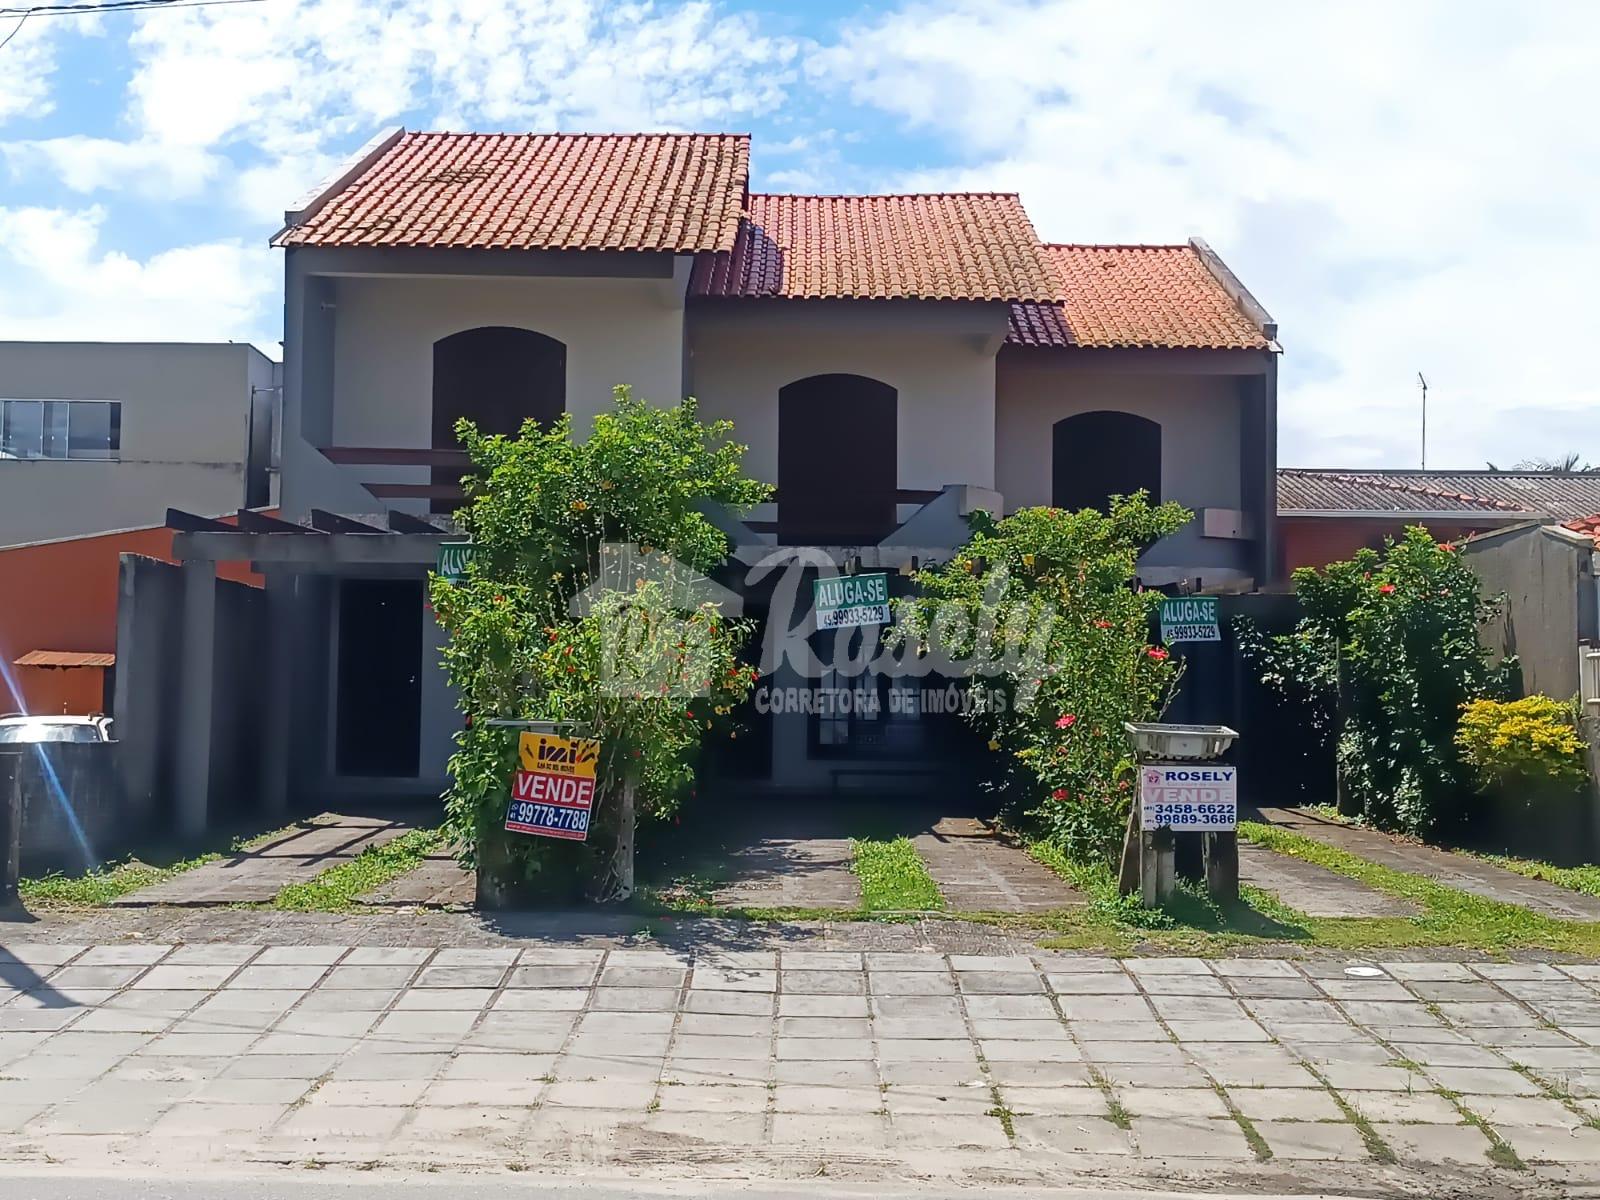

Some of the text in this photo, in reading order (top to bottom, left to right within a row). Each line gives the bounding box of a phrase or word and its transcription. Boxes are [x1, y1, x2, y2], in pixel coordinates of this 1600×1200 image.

[819, 579, 885, 607] ALUGA-SE
[1163, 601, 1215, 622] ALUGA-SE
[1165, 771, 1233, 782] ROSELY
[518, 773, 593, 805] VENDE
[1146, 788, 1234, 802] VENDE
[518, 802, 588, 830] 99778-7788
[1155, 804, 1235, 814] 3458-6622
[1155, 814, 1235, 824] 99889-3686
